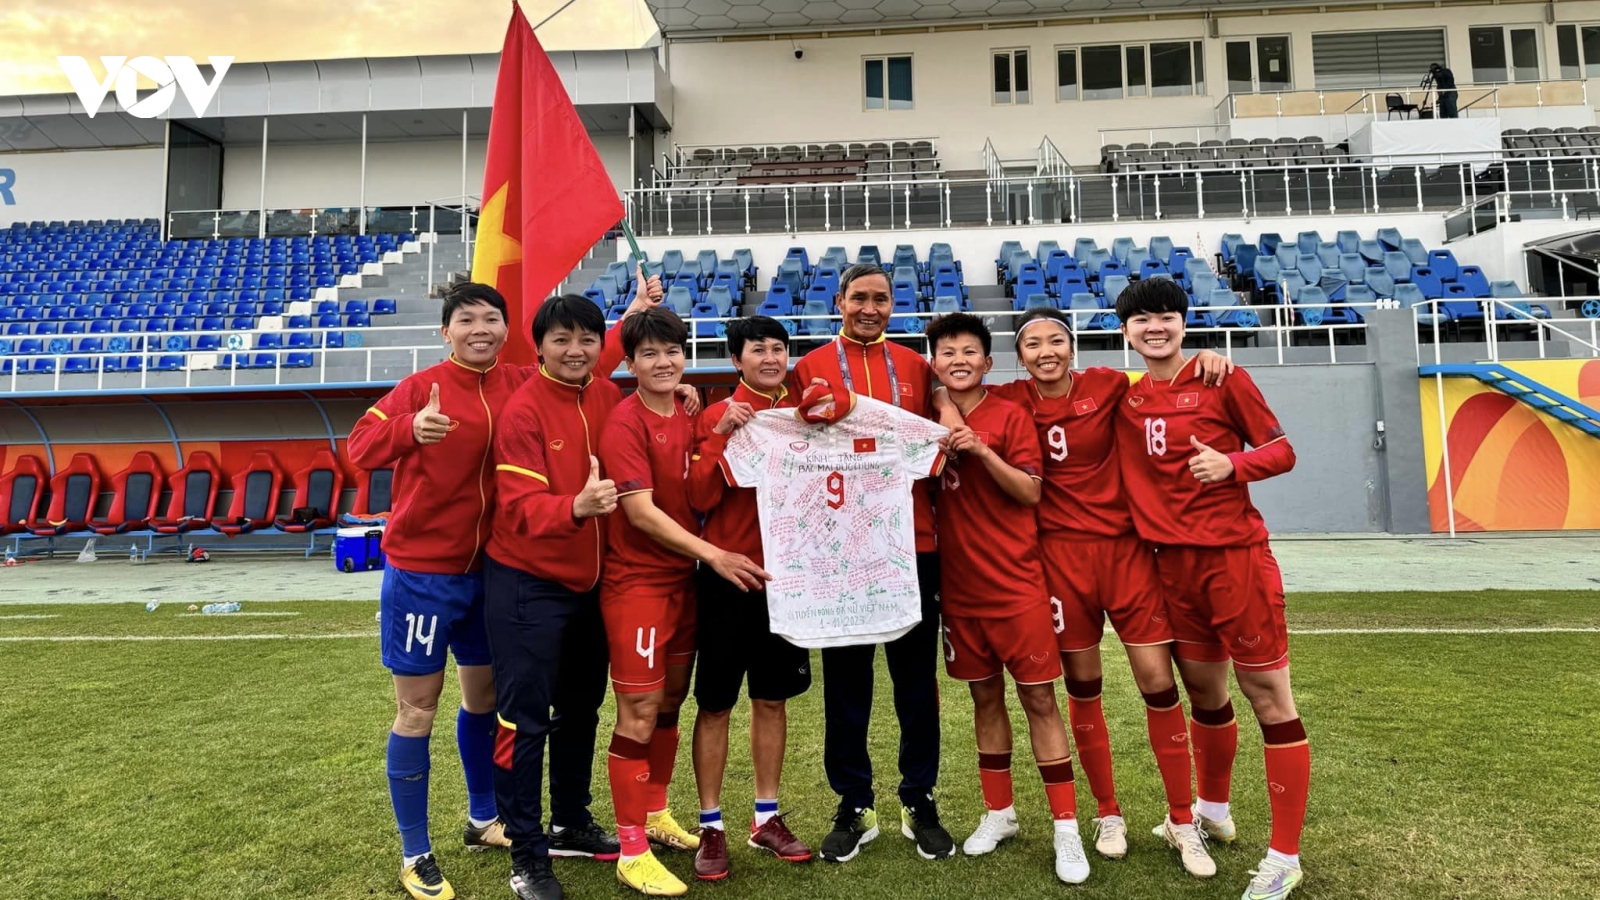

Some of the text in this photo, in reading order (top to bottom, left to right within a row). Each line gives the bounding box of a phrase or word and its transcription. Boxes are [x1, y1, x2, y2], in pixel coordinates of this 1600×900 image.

[1047, 424, 1069, 462] 9
[1143, 417, 1167, 456] 18
[826, 471, 844, 510] 9
[405, 613, 437, 656] 14
[636, 627, 656, 669] 4
